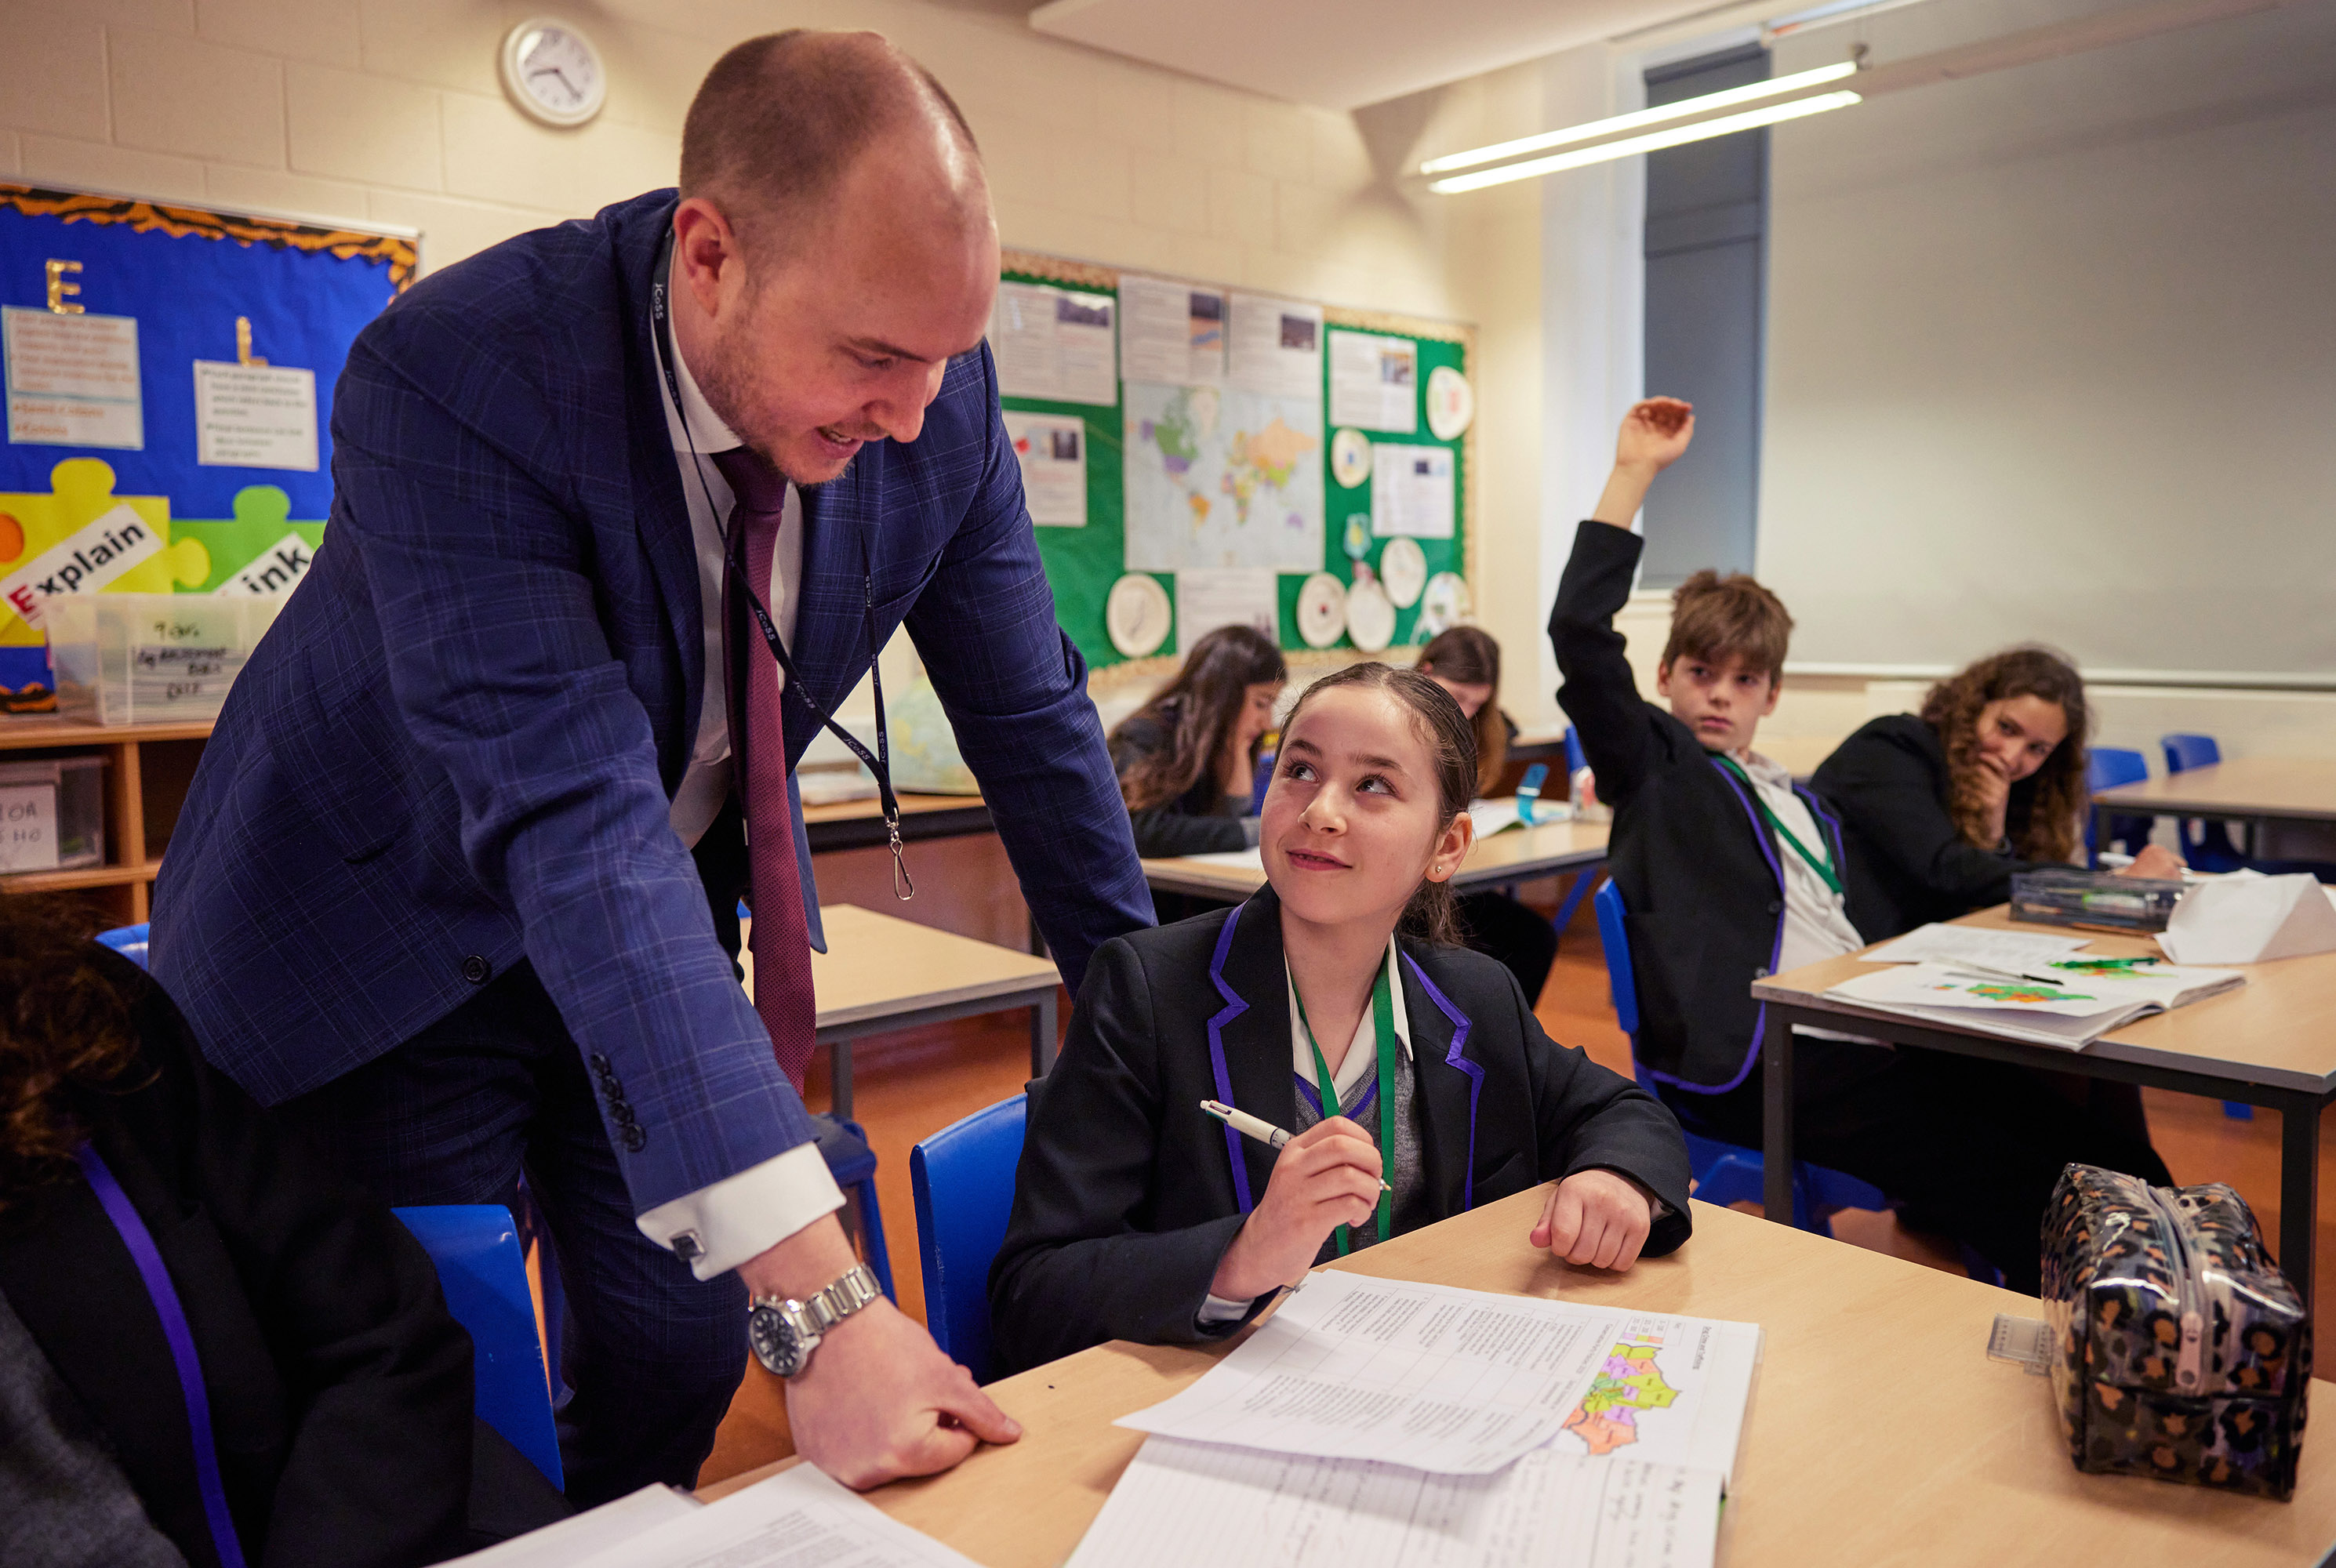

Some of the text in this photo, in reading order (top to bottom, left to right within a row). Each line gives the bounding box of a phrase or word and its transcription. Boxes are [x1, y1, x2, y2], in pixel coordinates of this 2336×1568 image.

[45, 258, 85, 314] E
[652, 282, 665, 321] JCoSS
[236, 316, 269, 368] L
[9, 521, 146, 615] Explain
[221, 546, 311, 597] ink
[754, 608, 775, 641] JCoSS
[842, 737, 871, 760] JCoSS
